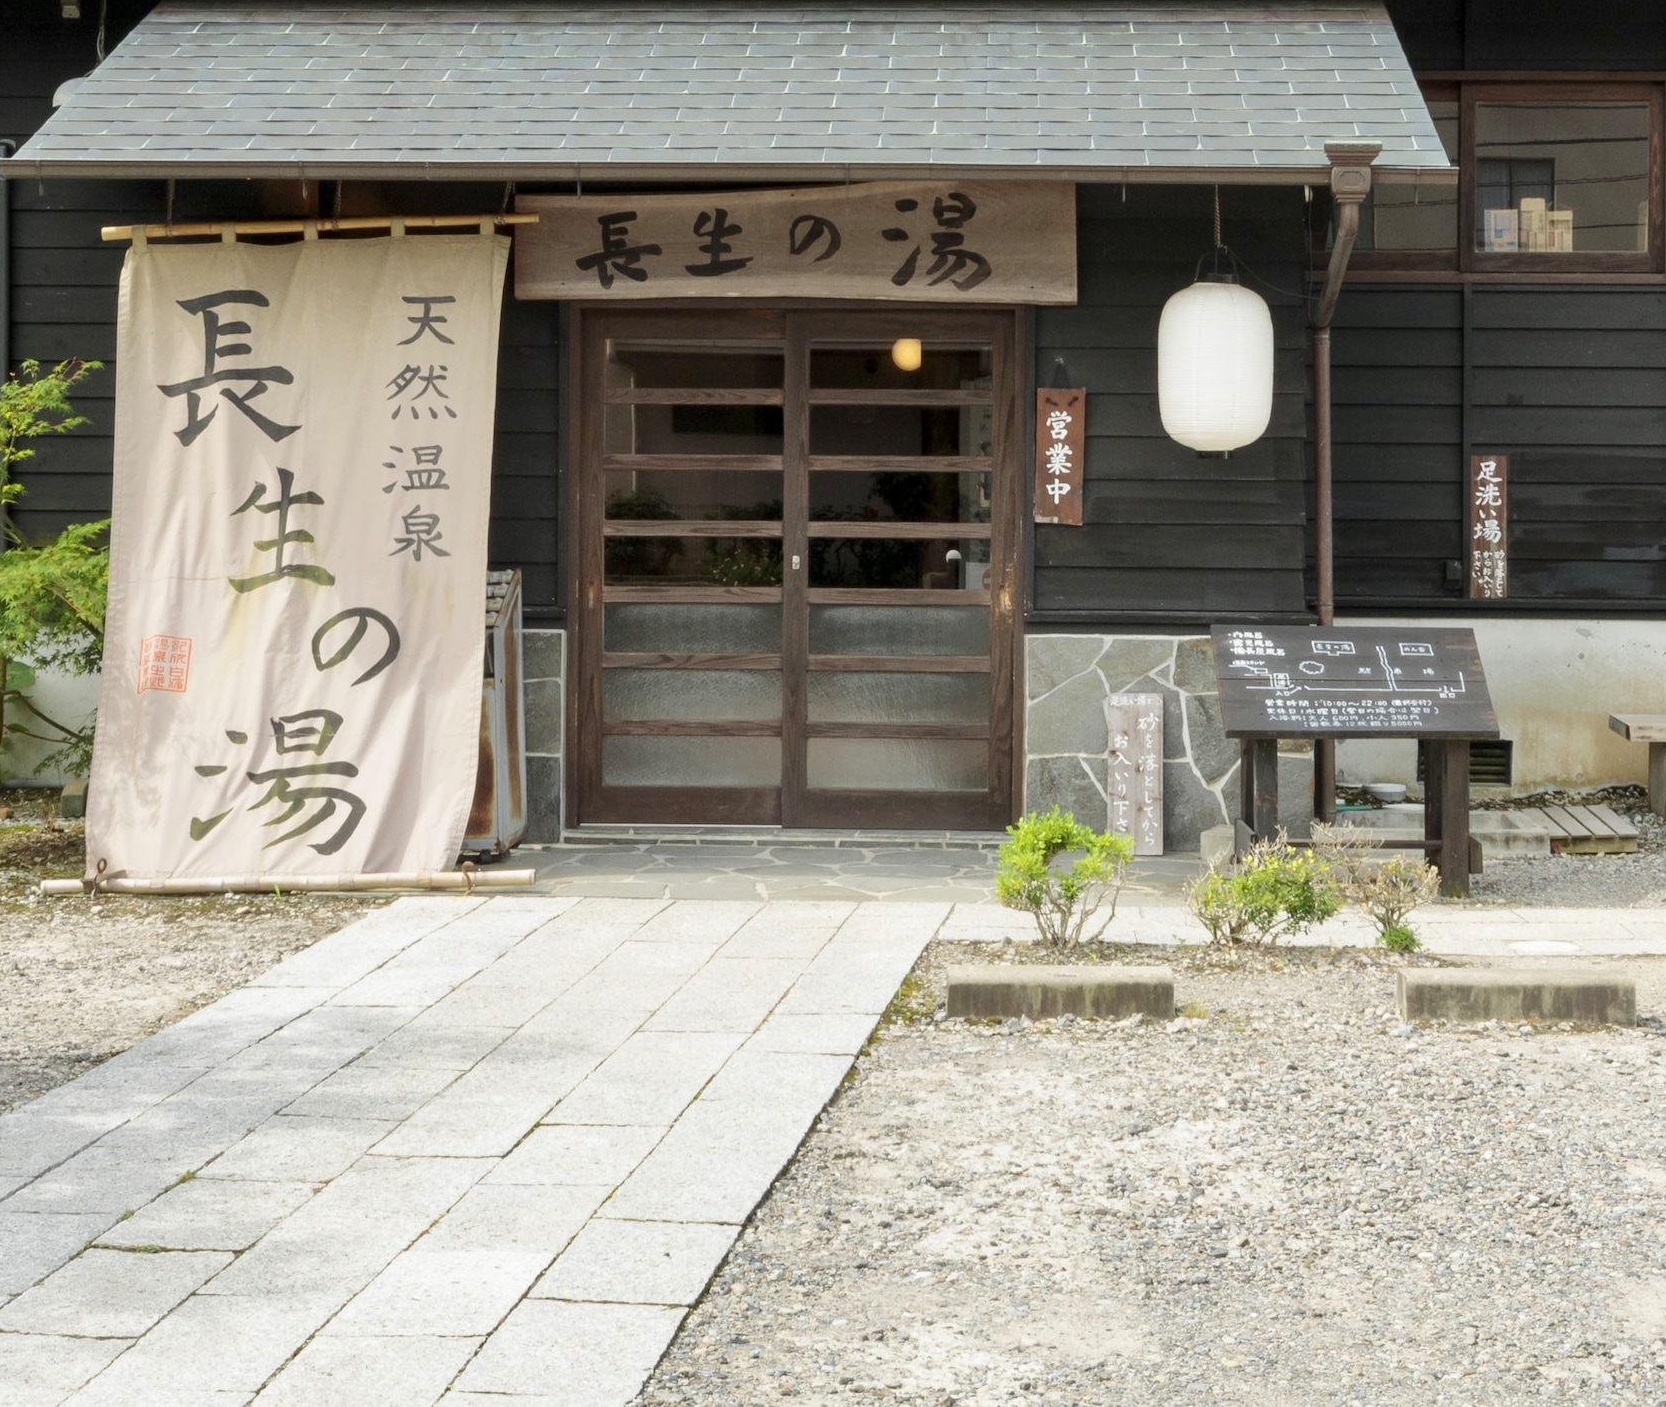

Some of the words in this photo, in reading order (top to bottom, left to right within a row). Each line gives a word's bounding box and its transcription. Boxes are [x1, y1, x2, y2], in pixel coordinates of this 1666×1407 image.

[575, 192, 992, 291] 長生の湯
[381, 294, 458, 562] 天然温泉
[1046, 410, 1072, 505] 営業中
[1473, 460, 1503, 544] 足洗い場
[157, 290, 400, 856] 長生の湯
[1113, 734, 1132, 832] お入いり下さ
[1137, 712, 1160, 846] 砂を落としてから
